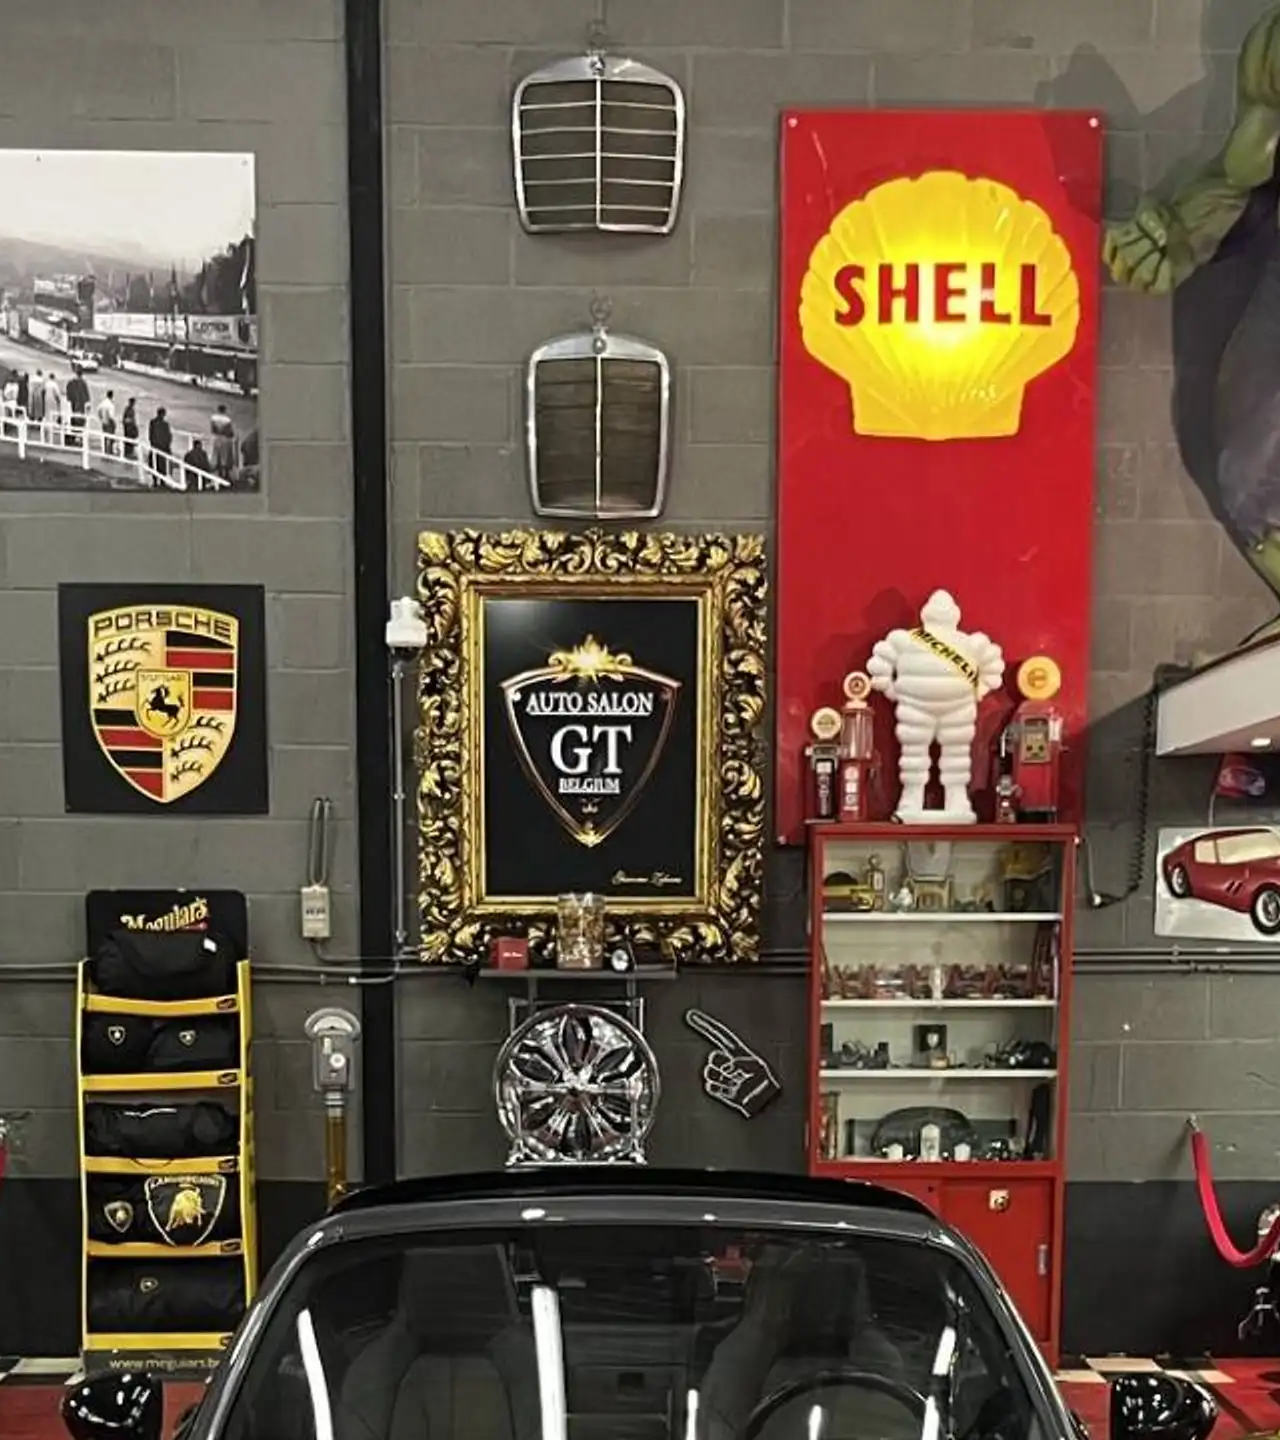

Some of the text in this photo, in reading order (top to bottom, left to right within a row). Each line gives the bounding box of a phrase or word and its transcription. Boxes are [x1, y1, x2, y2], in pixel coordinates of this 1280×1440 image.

[833, 262, 1053, 328] SHELL
[94, 610, 232, 640] PORSCHE
[526, 691, 654, 713] AUTO SALON
[550, 724, 633, 776] GT
[559, 777, 620, 793] BELGIUM
